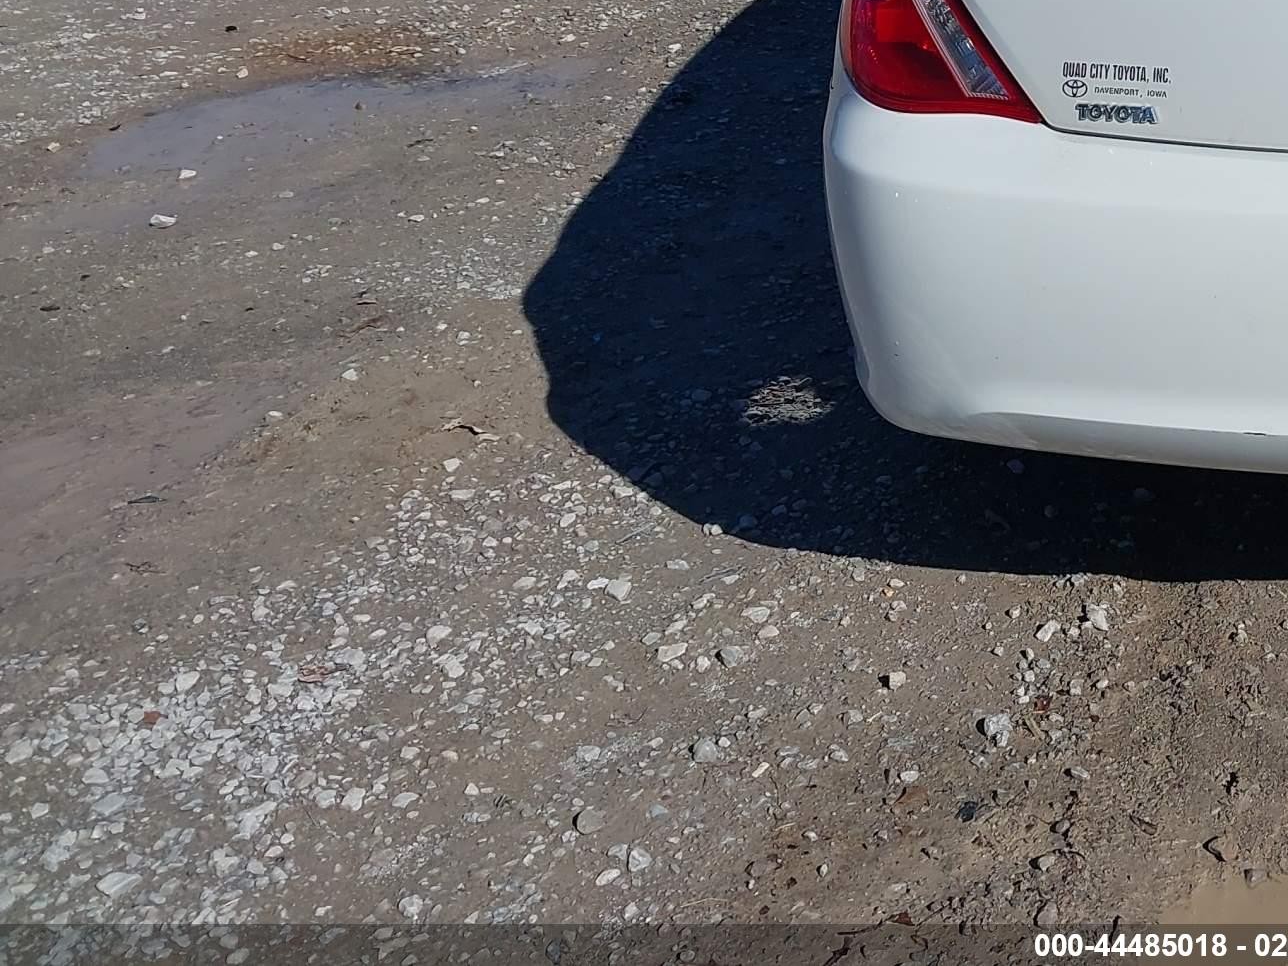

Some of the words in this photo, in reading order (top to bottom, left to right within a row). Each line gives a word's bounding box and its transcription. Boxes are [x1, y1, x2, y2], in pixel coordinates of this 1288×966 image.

[1062, 61, 1087, 78] QUAD
[1090, 63, 1110, 79] CITY
[1113, 64, 1150, 83] TOYOTA,
[1153, 67, 1172, 84] INC.
[1094, 86, 1143, 98] DAVENPORT,
[1147, 90, 1168, 98] IOWA
[1075, 103, 1159, 124] TOYOTA
